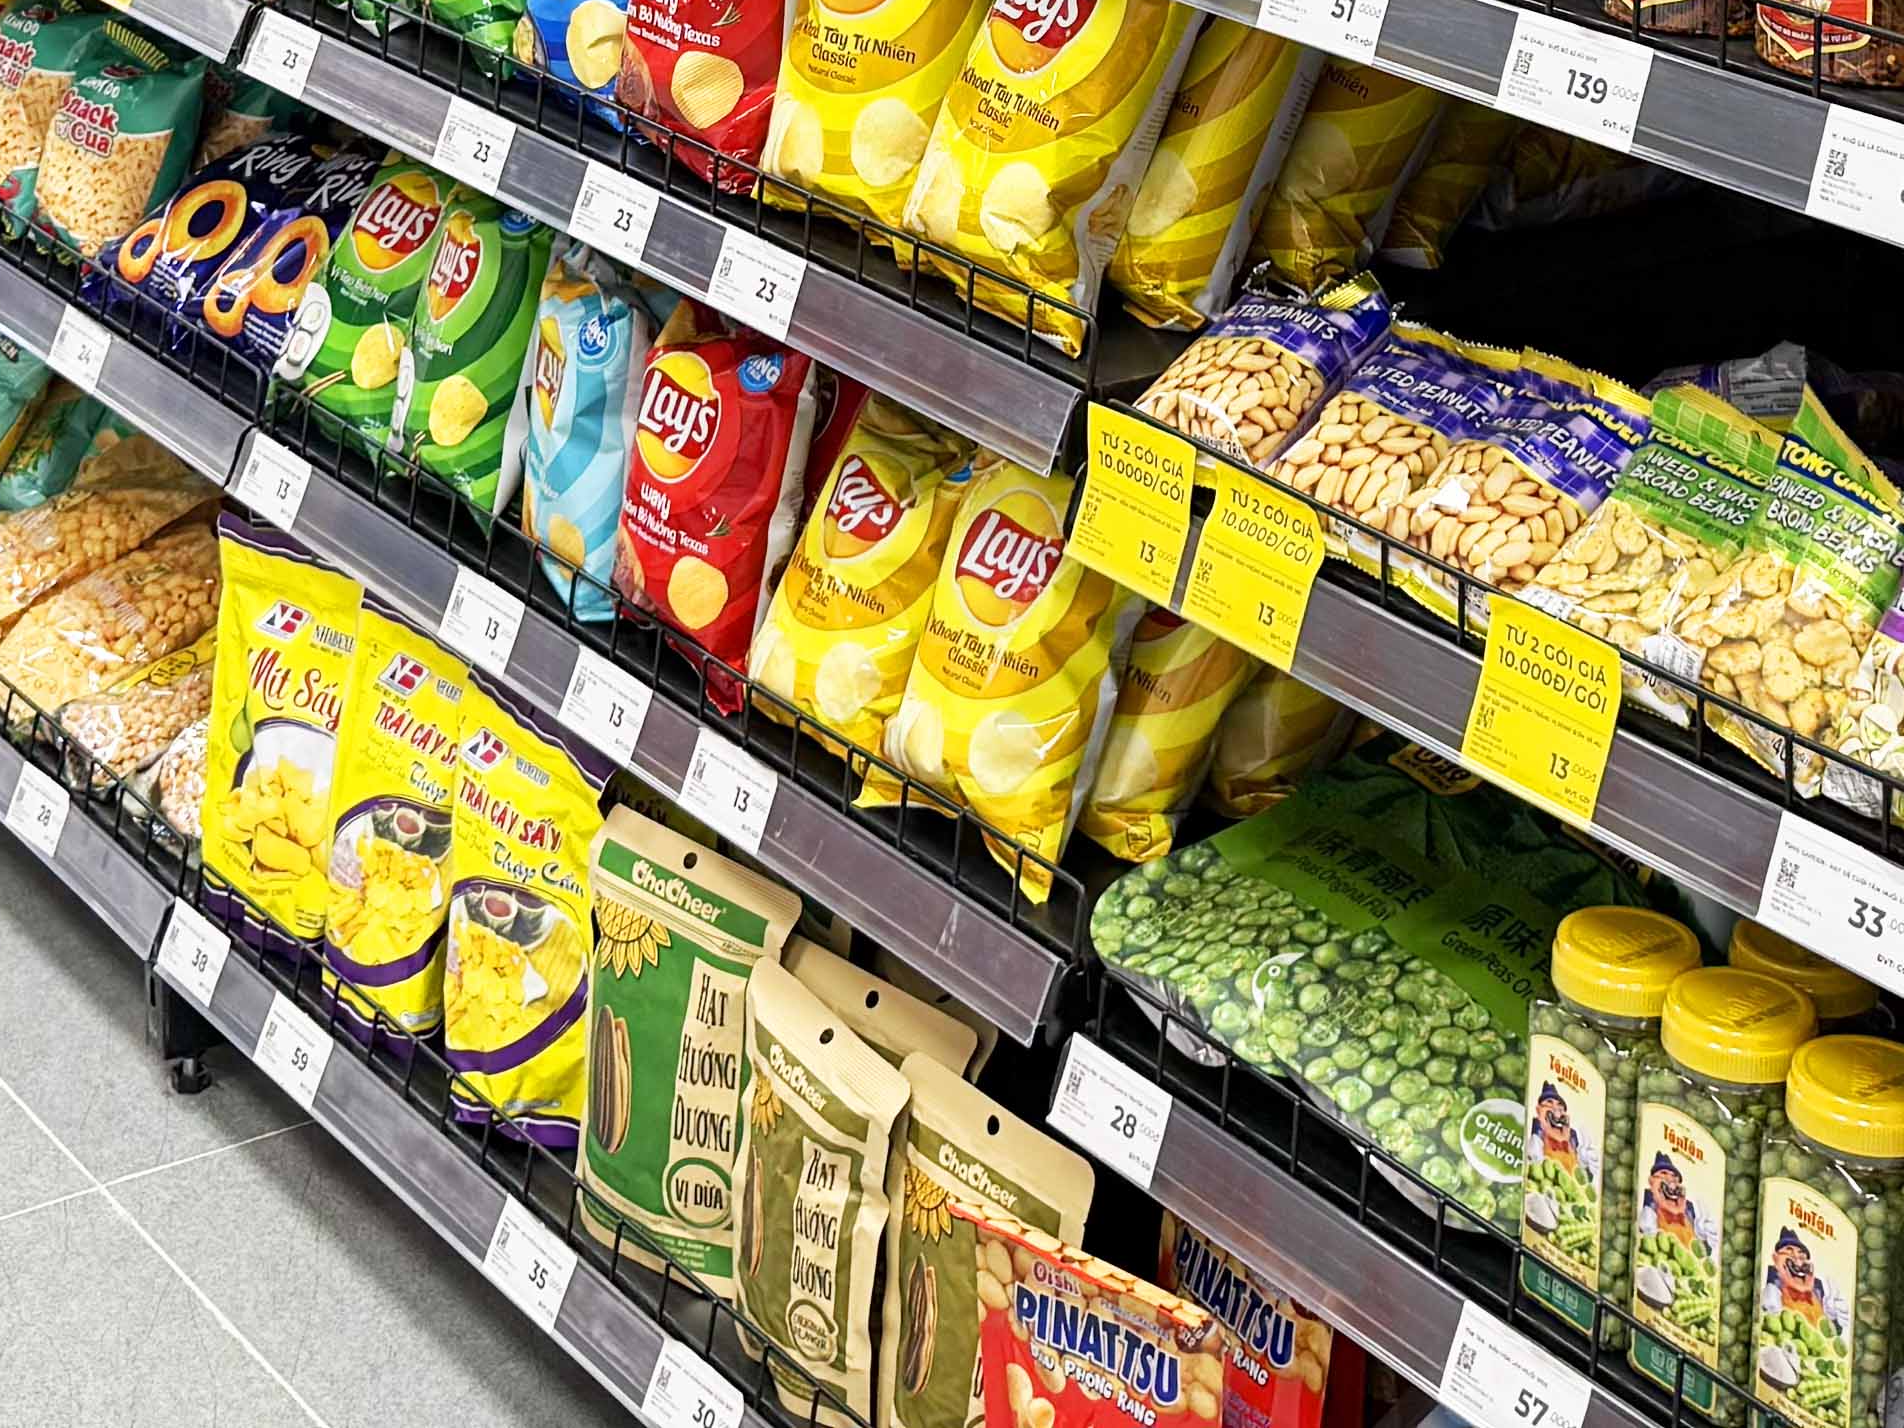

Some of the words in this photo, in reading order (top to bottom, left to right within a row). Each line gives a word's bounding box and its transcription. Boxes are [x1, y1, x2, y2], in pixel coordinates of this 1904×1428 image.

[811, 45, 857, 70] Classic
[1566, 70, 1609, 104] 139
[755, 278, 776, 302] 23
[1266, 303, 1338, 341] PEANUTS
[638, 372, 719, 459] Lay's
[957, 516, 1060, 600] Lay's
[252, 645, 288, 700] Mít
[518, 816, 562, 855] SẤY
[633, 860, 725, 925] ChaCheer
[1848, 897, 1887, 938] 33
[191, 949, 208, 970] 38
[698, 975, 728, 1029] HẠT
[677, 1052, 737, 1092] HƯỚNG
[675, 1179, 695, 1208] VỊ
[938, 1143, 1018, 1210] ChaCheer
[528, 1263, 549, 1291] 35
[1014, 1280, 1180, 1403] PINATTSU
